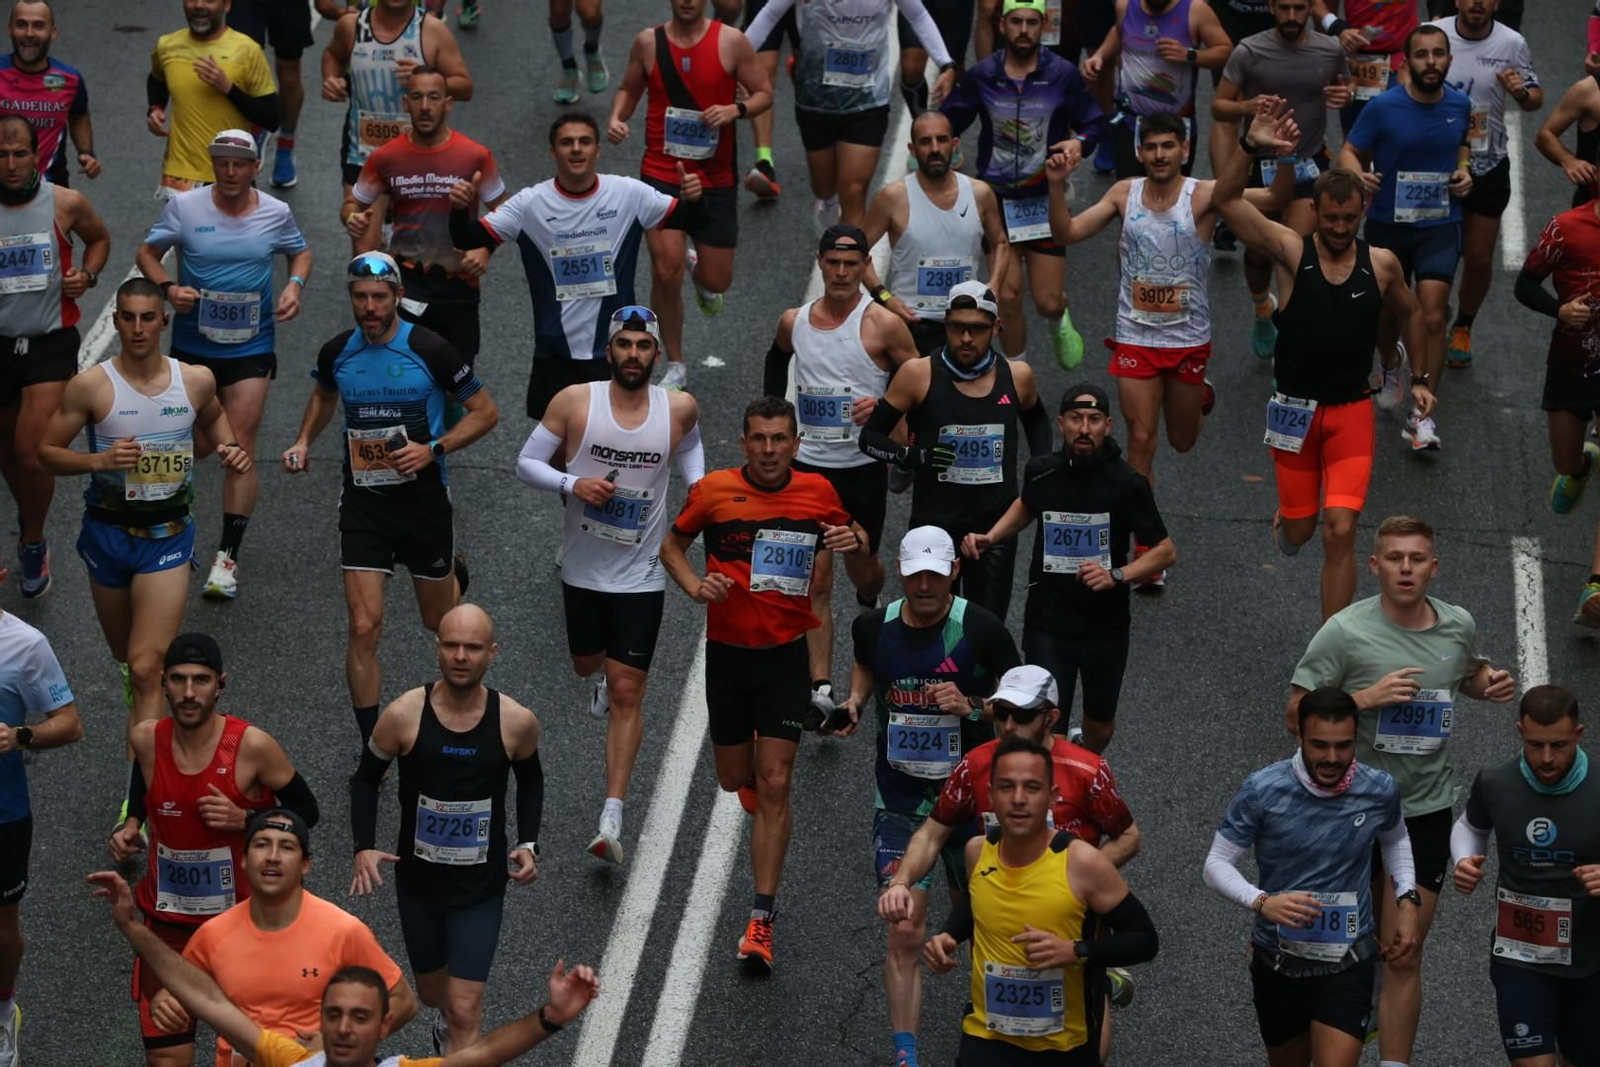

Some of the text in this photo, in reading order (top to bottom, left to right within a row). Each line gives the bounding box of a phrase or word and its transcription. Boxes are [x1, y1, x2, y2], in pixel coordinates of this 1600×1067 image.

[834, 52, 867, 67] 2807
[366, 124, 400, 139] 6309
[673, 121, 706, 139] 2292
[1406, 185, 1440, 201] 2254
[0, 249, 37, 270] 2447
[561, 258, 598, 276] 2551
[926, 271, 961, 287] 2381
[1139, 287, 1175, 304] 3902
[209, 304, 247, 321] 3361
[803, 399, 837, 418] 3083
[1274, 407, 1308, 428] 1724
[360, 443, 393, 461] 463
[596, 500, 636, 519] 081
[1053, 528, 1094, 548] 2671
[763, 546, 805, 568] 2810
[1391, 706, 1437, 726] 2991
[898, 730, 943, 751] 2324
[442, 745, 478, 756] SAYSKY
[426, 815, 474, 837] 2726
[167, 864, 213, 886] 2801
[1513, 909, 1546, 934] 565
[994, 982, 1046, 1007] 2325
